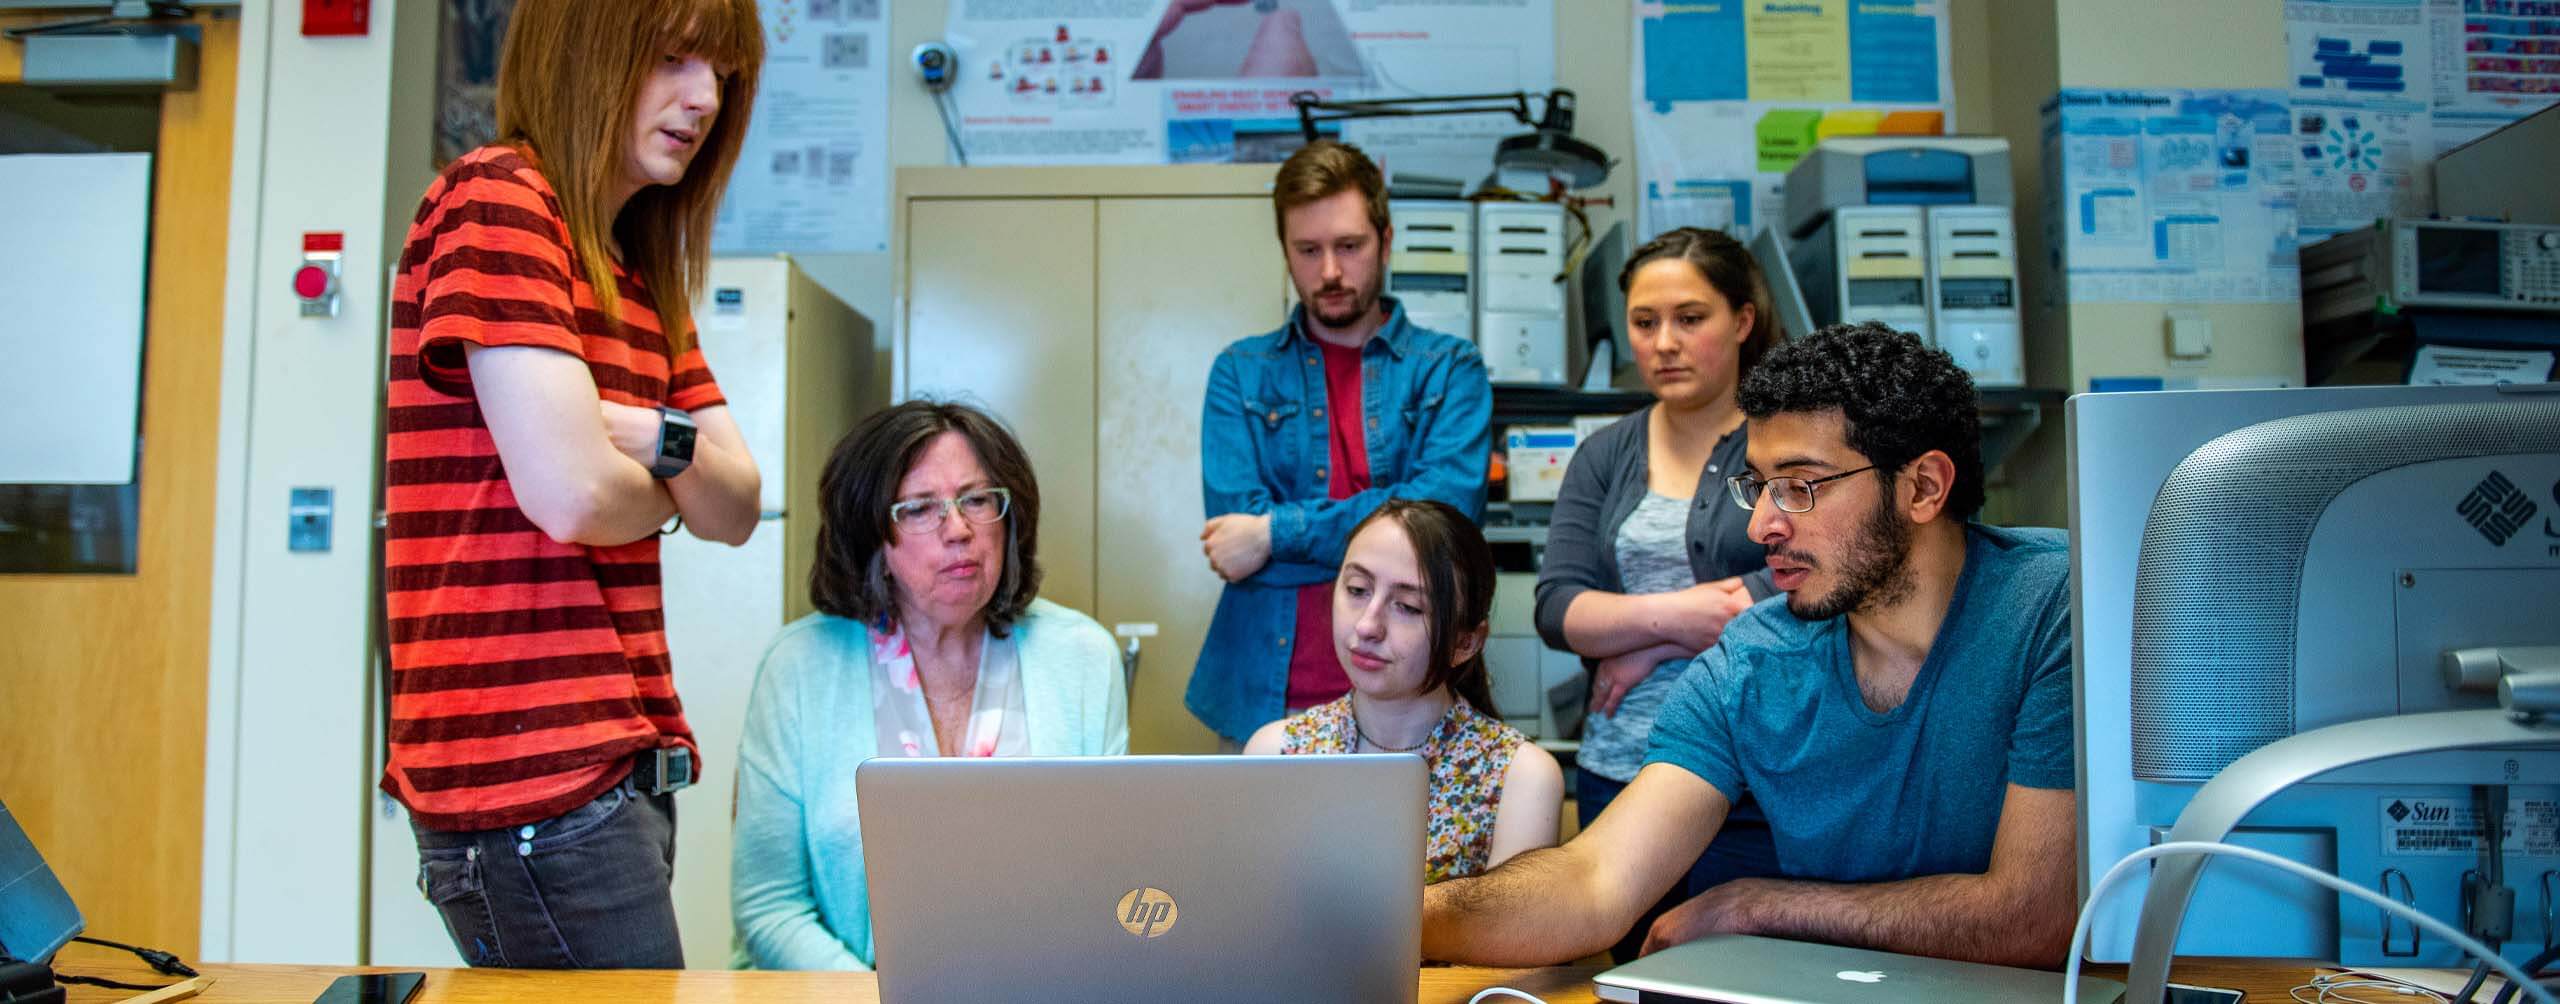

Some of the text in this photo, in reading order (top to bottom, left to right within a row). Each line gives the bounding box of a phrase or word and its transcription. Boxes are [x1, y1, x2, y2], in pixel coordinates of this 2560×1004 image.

[1763, 3, 1822, 16] Modeling
[2105, 93, 2171, 108] Techniques
[2411, 802, 2449, 821] Sun
[1126, 888, 1171, 937] hp
